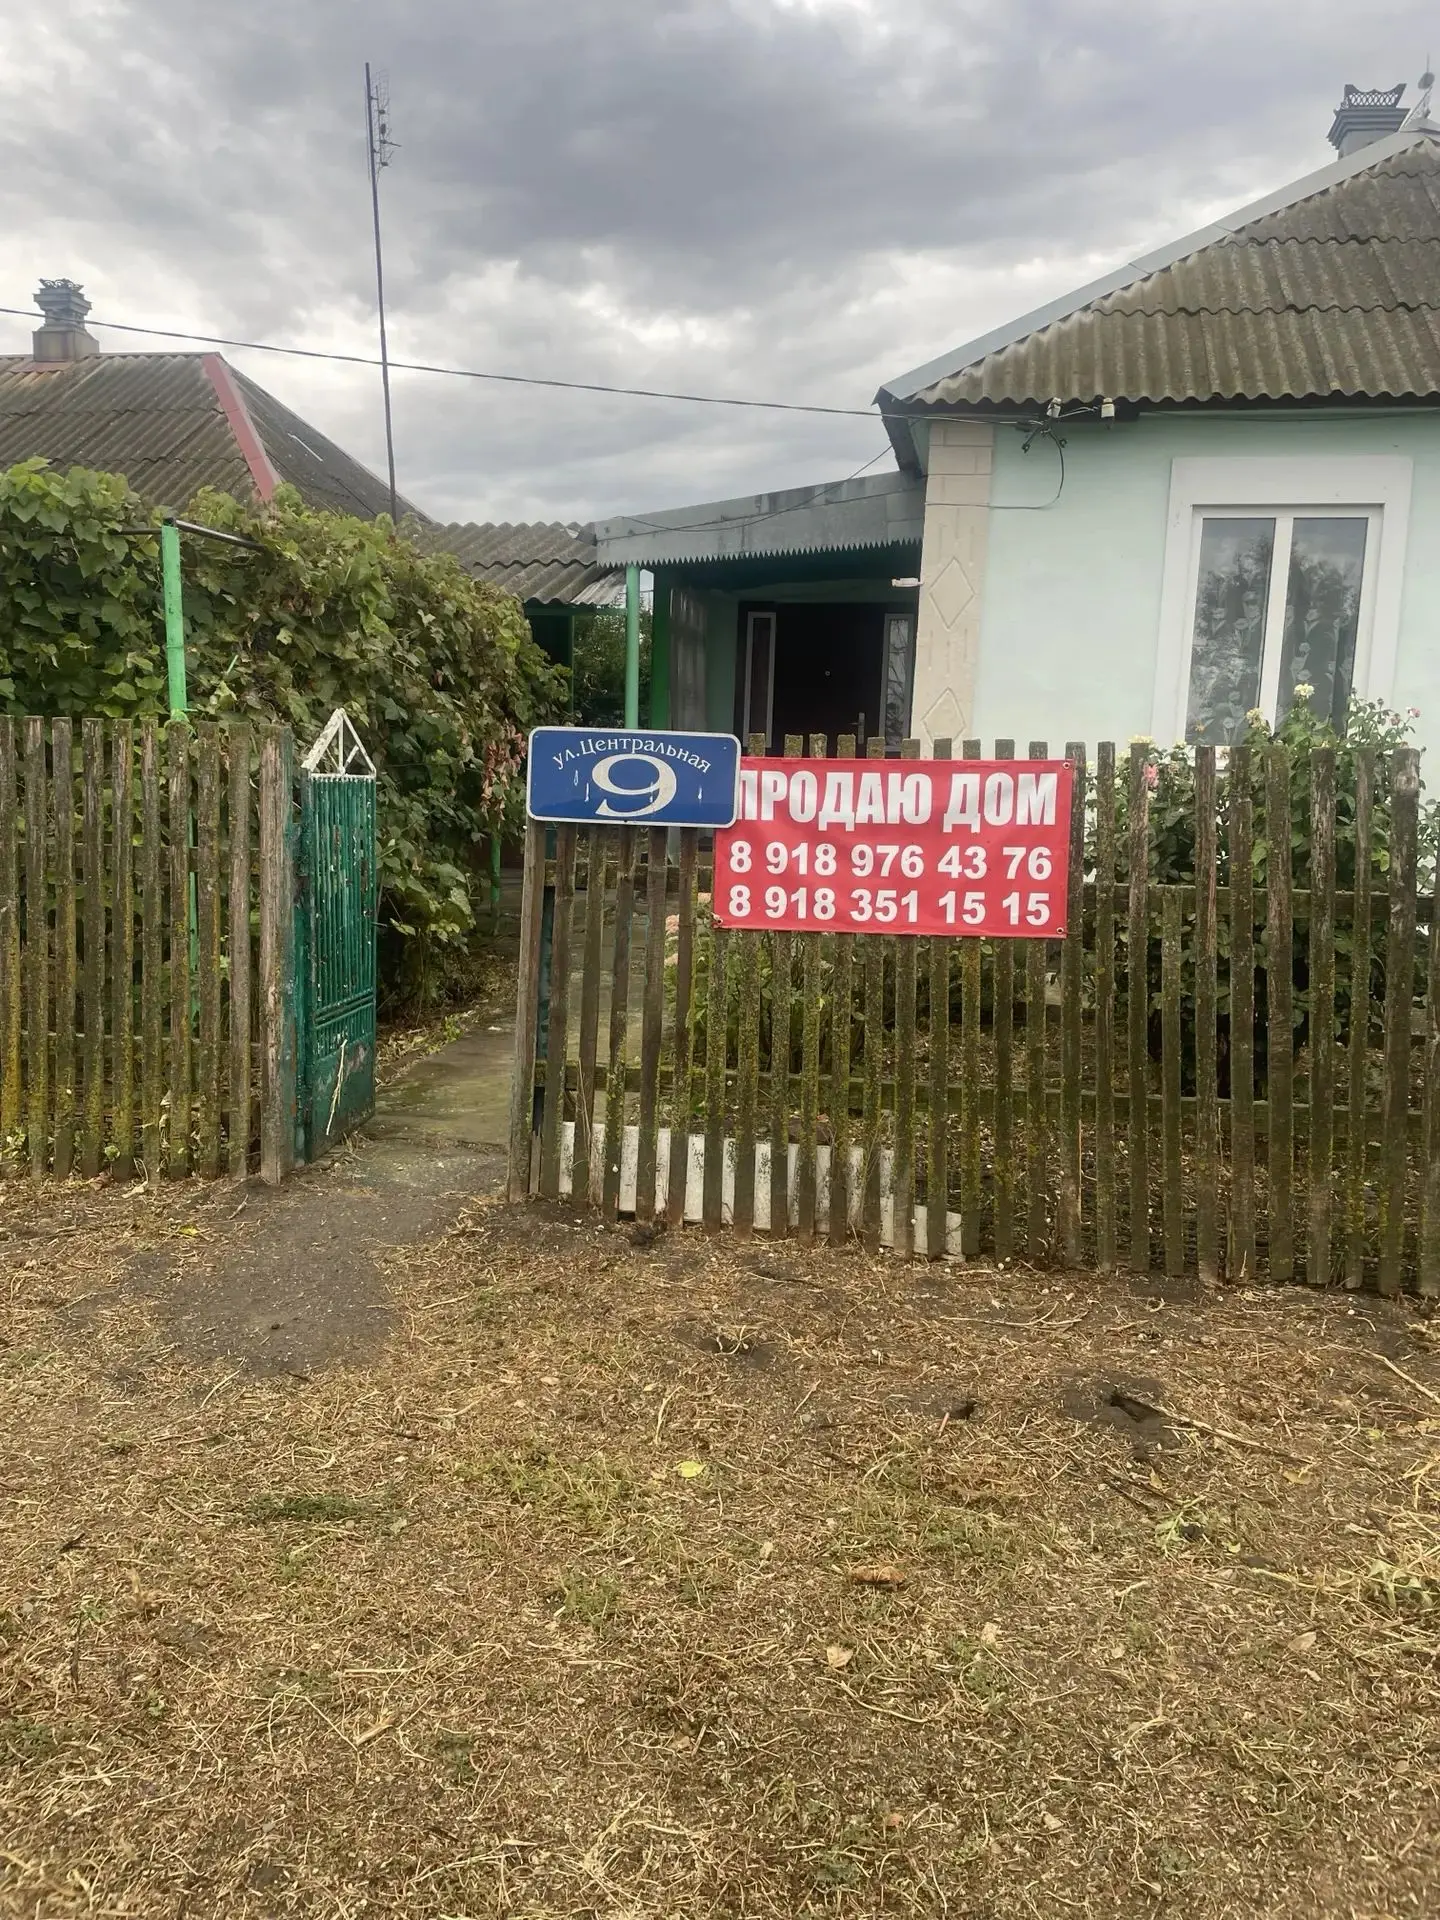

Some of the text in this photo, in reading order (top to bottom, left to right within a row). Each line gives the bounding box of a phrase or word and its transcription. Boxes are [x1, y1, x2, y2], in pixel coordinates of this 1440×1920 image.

[591, 753, 677, 817] 9
[737, 770, 1058, 833] ПРОДАЮ ДОМ
[729, 840, 1052, 881] 8 918 976 43 76
[728, 885, 1050, 926] 8 918 351 15 15
